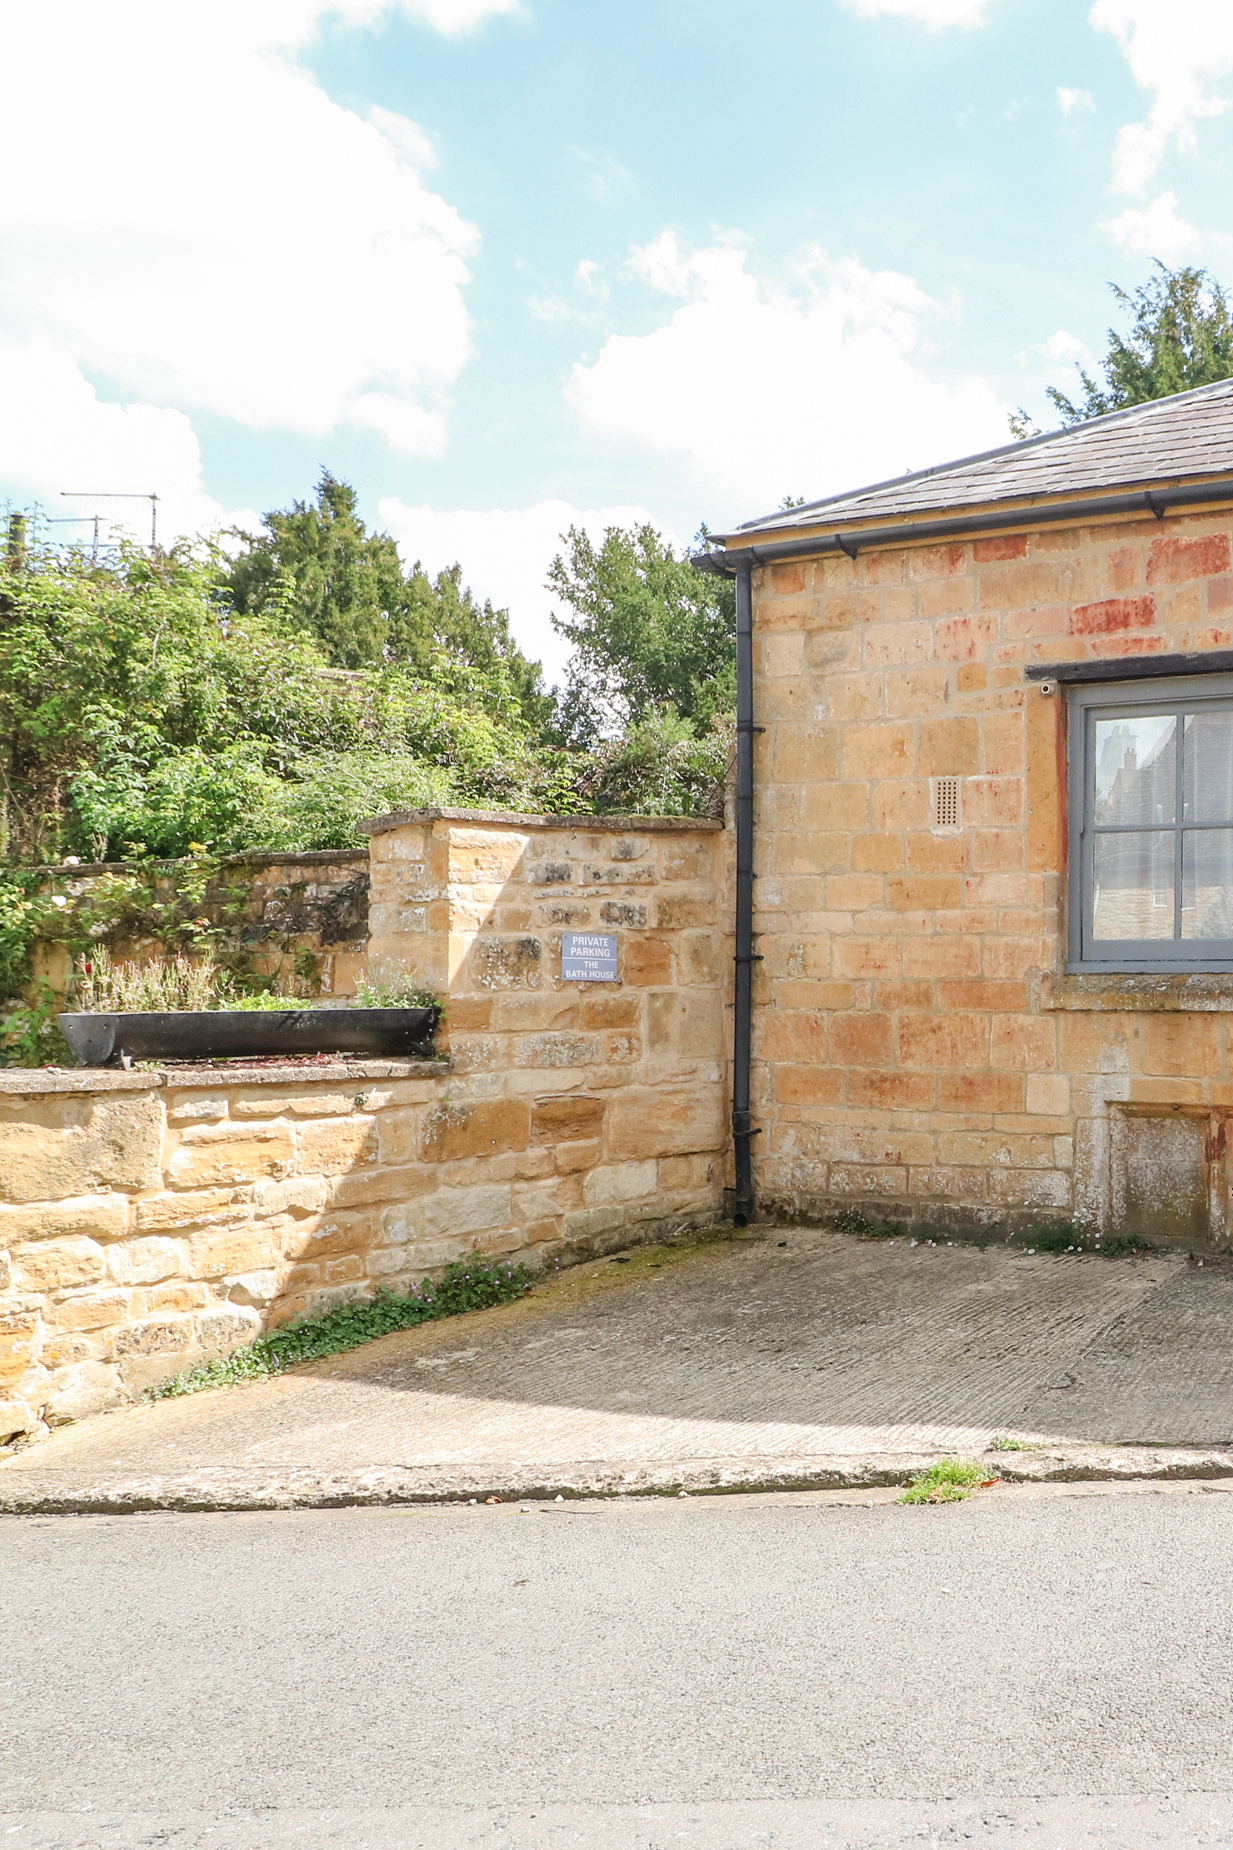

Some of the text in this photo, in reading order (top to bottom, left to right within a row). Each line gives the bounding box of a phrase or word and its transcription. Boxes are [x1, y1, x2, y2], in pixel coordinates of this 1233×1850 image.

[572, 936, 609, 947] PRIVATE
[570, 947, 611, 957] PARKING
[583, 960, 599, 969] THE
[565, 970, 615, 979] BATH HOUSE
